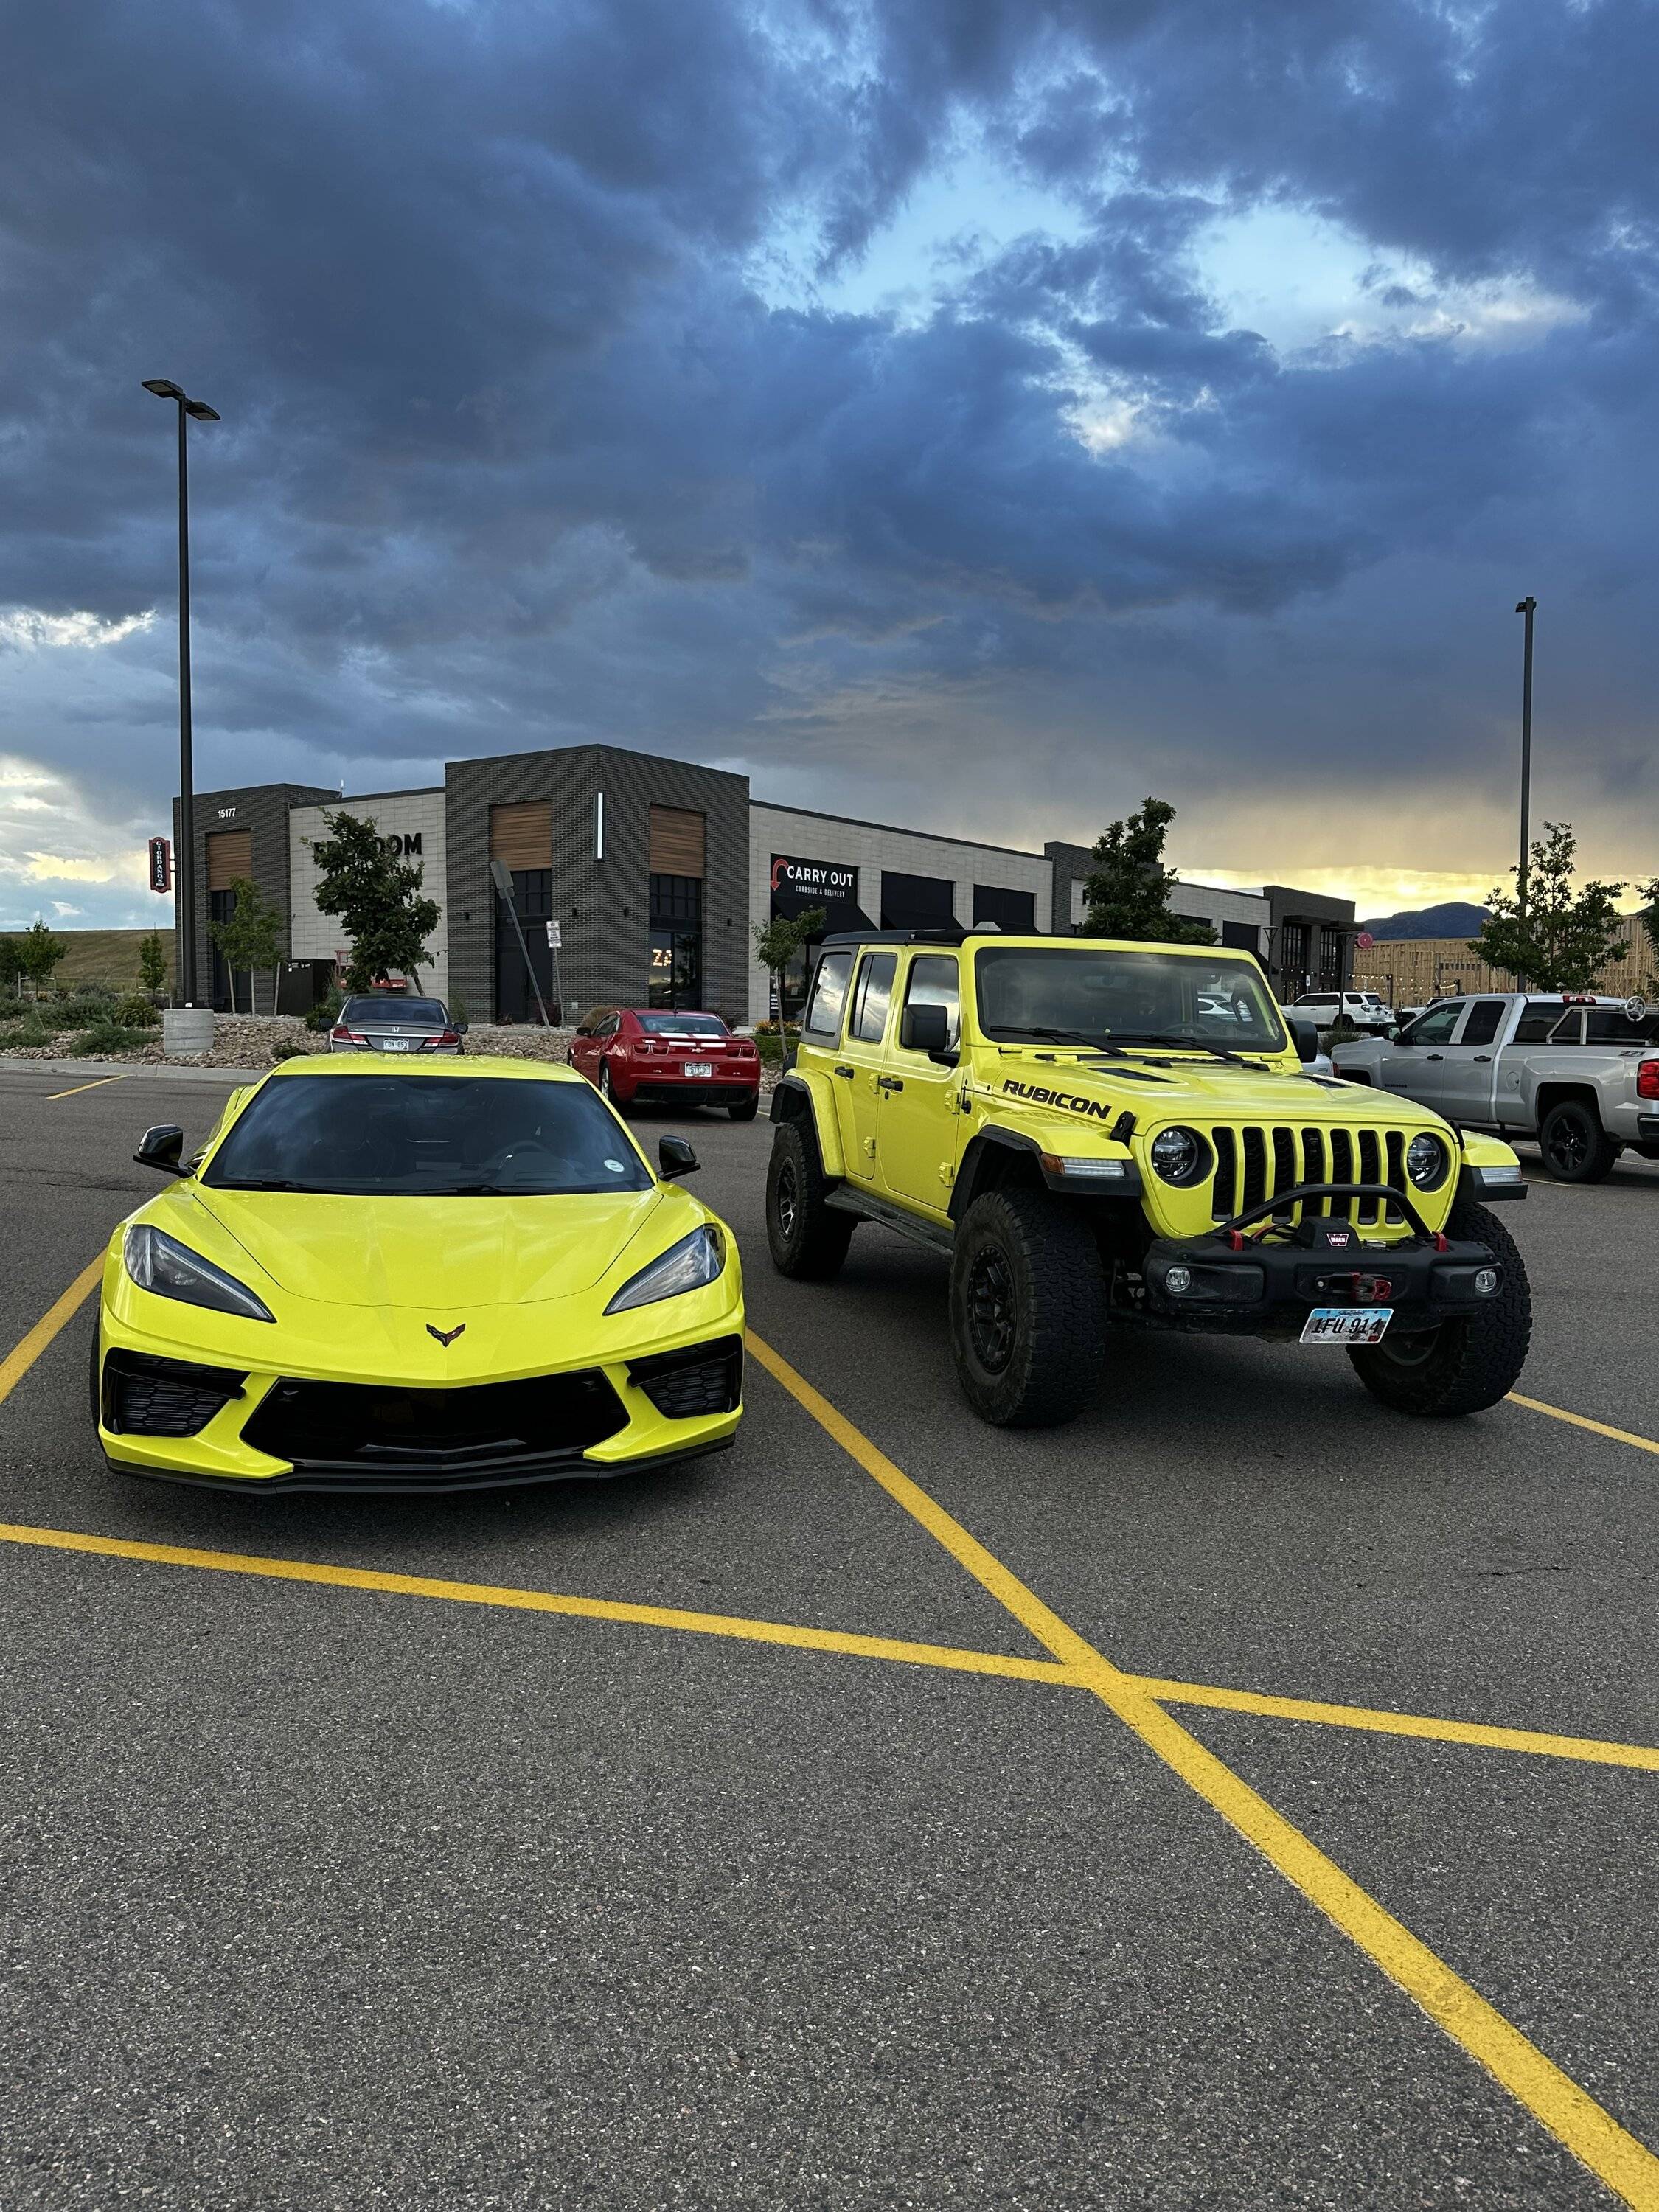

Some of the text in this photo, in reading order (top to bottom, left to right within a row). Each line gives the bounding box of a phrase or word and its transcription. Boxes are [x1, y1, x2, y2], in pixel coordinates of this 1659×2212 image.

[218, 807, 236, 818] 15177
[787, 865, 854, 887] CARRY OUT
[796, 885, 818, 894] CURBSIDE
[824, 888, 845, 898] DELIVERY
[1002, 1079, 1113, 1120] RUBICON
[1311, 1318, 1382, 1334] 1FU 914
